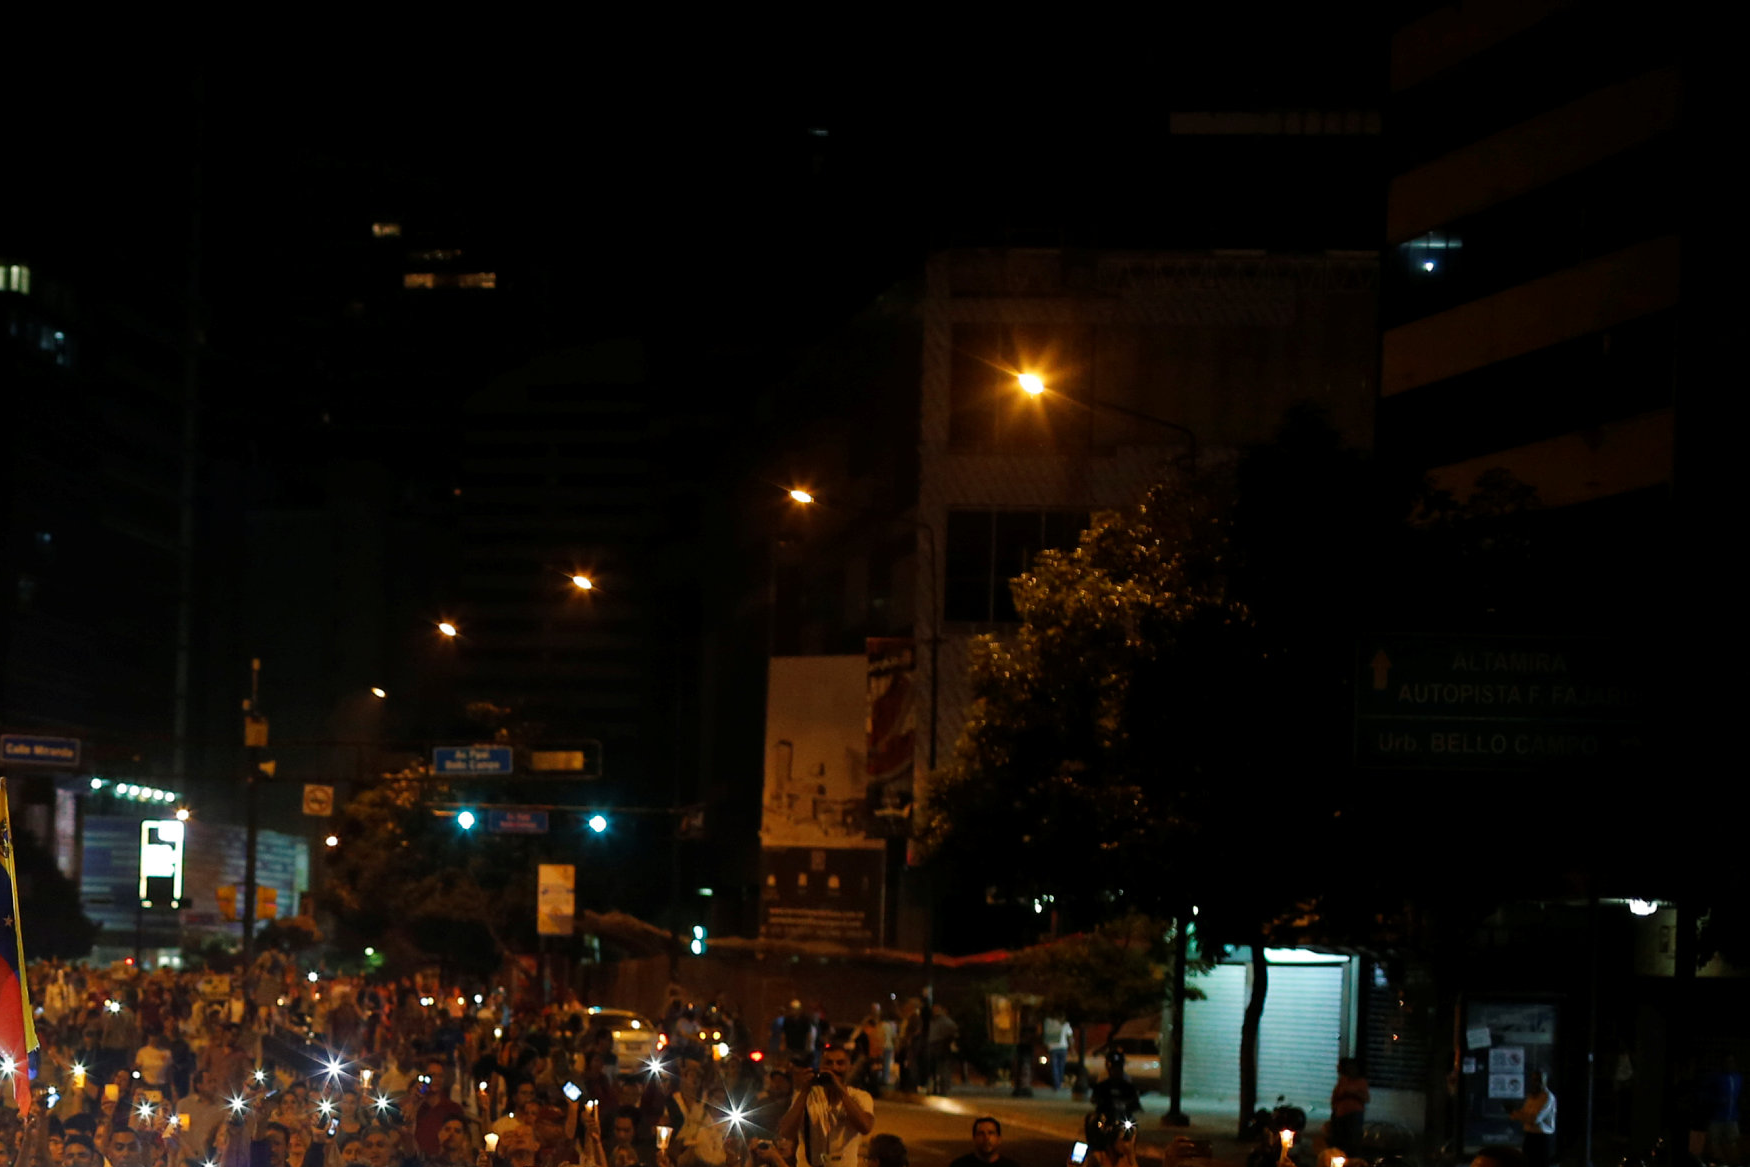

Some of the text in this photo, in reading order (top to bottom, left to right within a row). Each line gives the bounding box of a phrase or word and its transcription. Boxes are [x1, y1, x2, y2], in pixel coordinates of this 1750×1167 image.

[1451, 651, 1568, 673] ALTAMIRA
[1397, 682, 1523, 705] AUTOPISTA
[1429, 732, 1508, 755] BELLO
